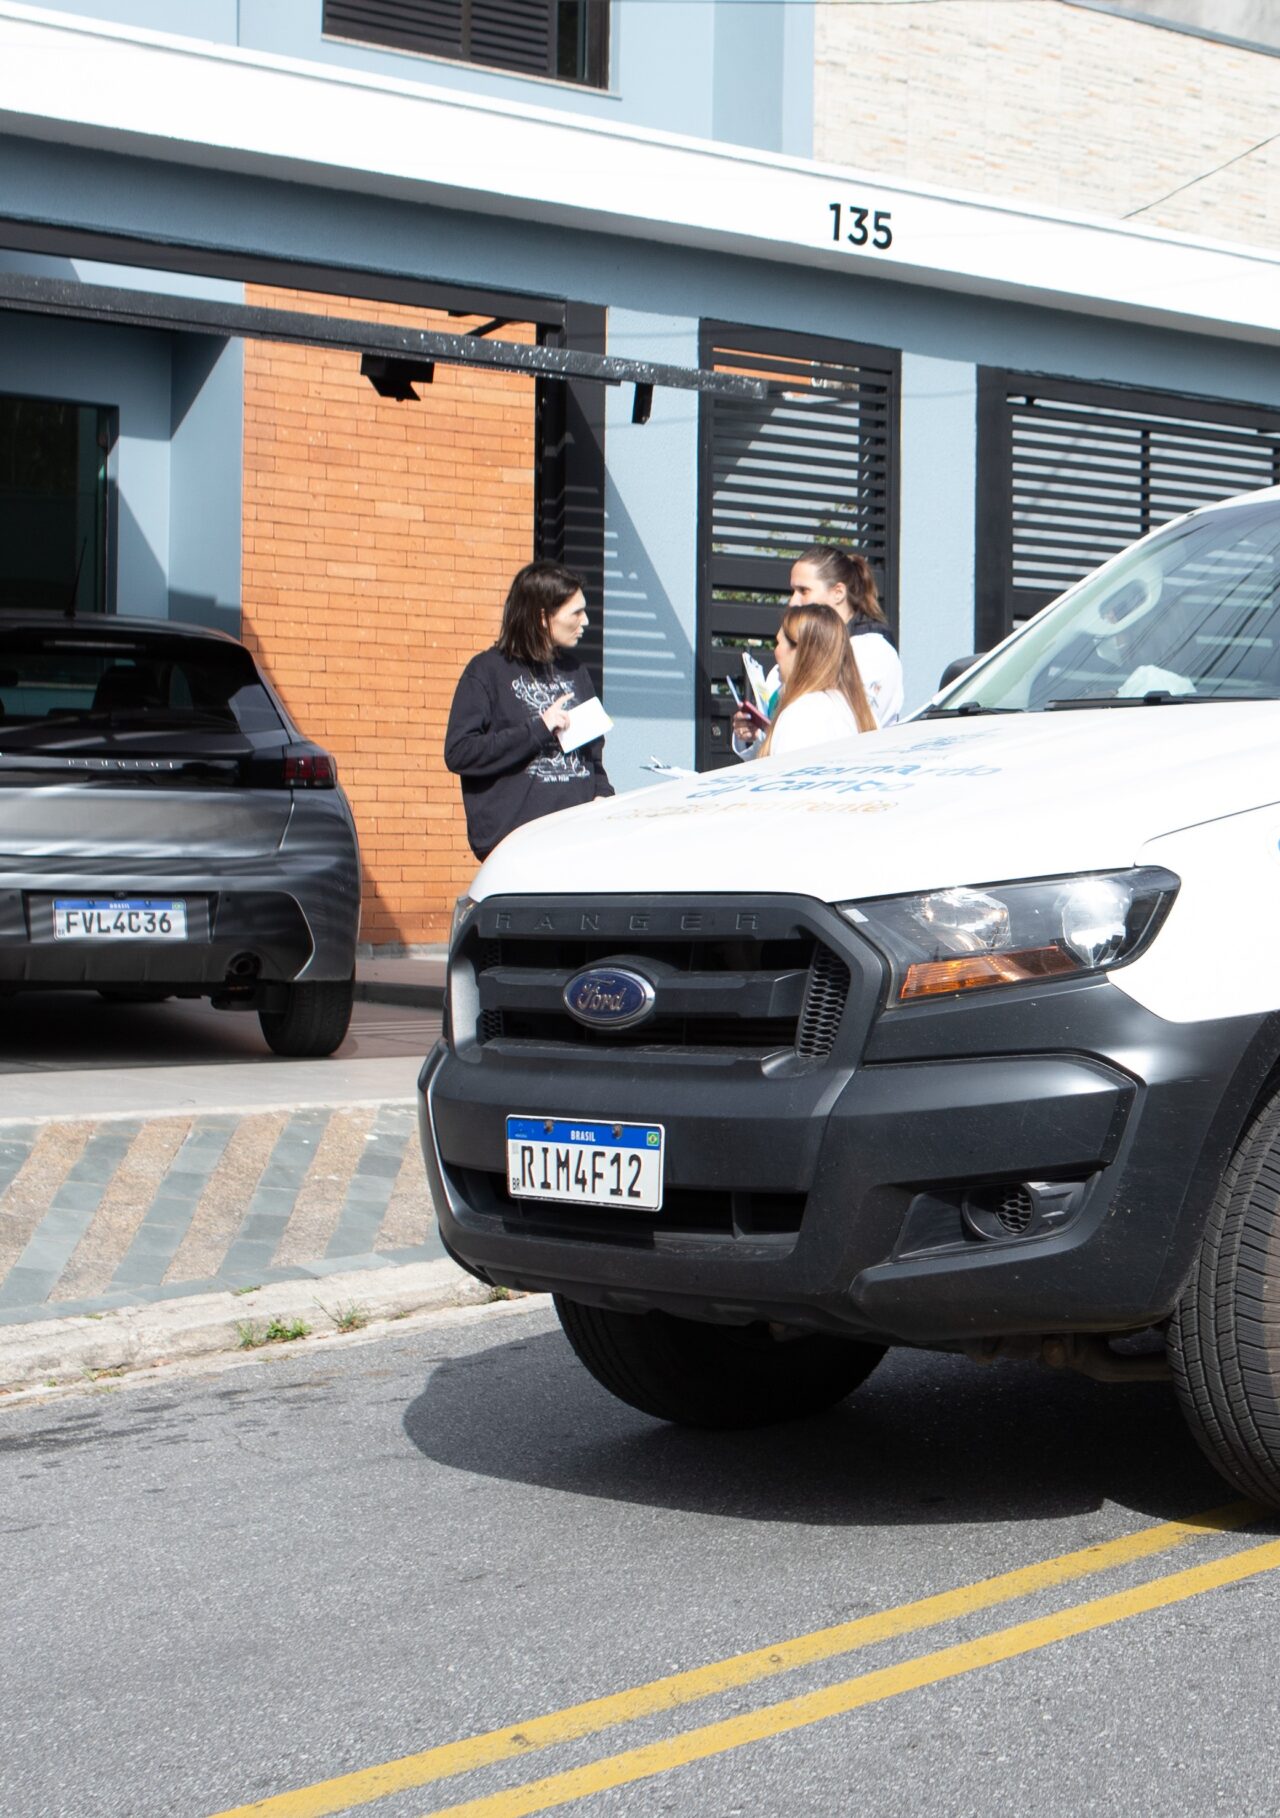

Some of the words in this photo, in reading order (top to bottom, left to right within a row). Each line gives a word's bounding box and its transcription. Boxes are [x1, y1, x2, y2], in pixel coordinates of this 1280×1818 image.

[828, 202, 893, 250] 135
[65, 911, 173, 934] FVL4C36
[495, 912, 759, 931] RANGER
[575, 976, 627, 1012] Ford
[570, 1129, 596, 1142] BRASIL
[521, 1145, 642, 1198] RIM4F12
